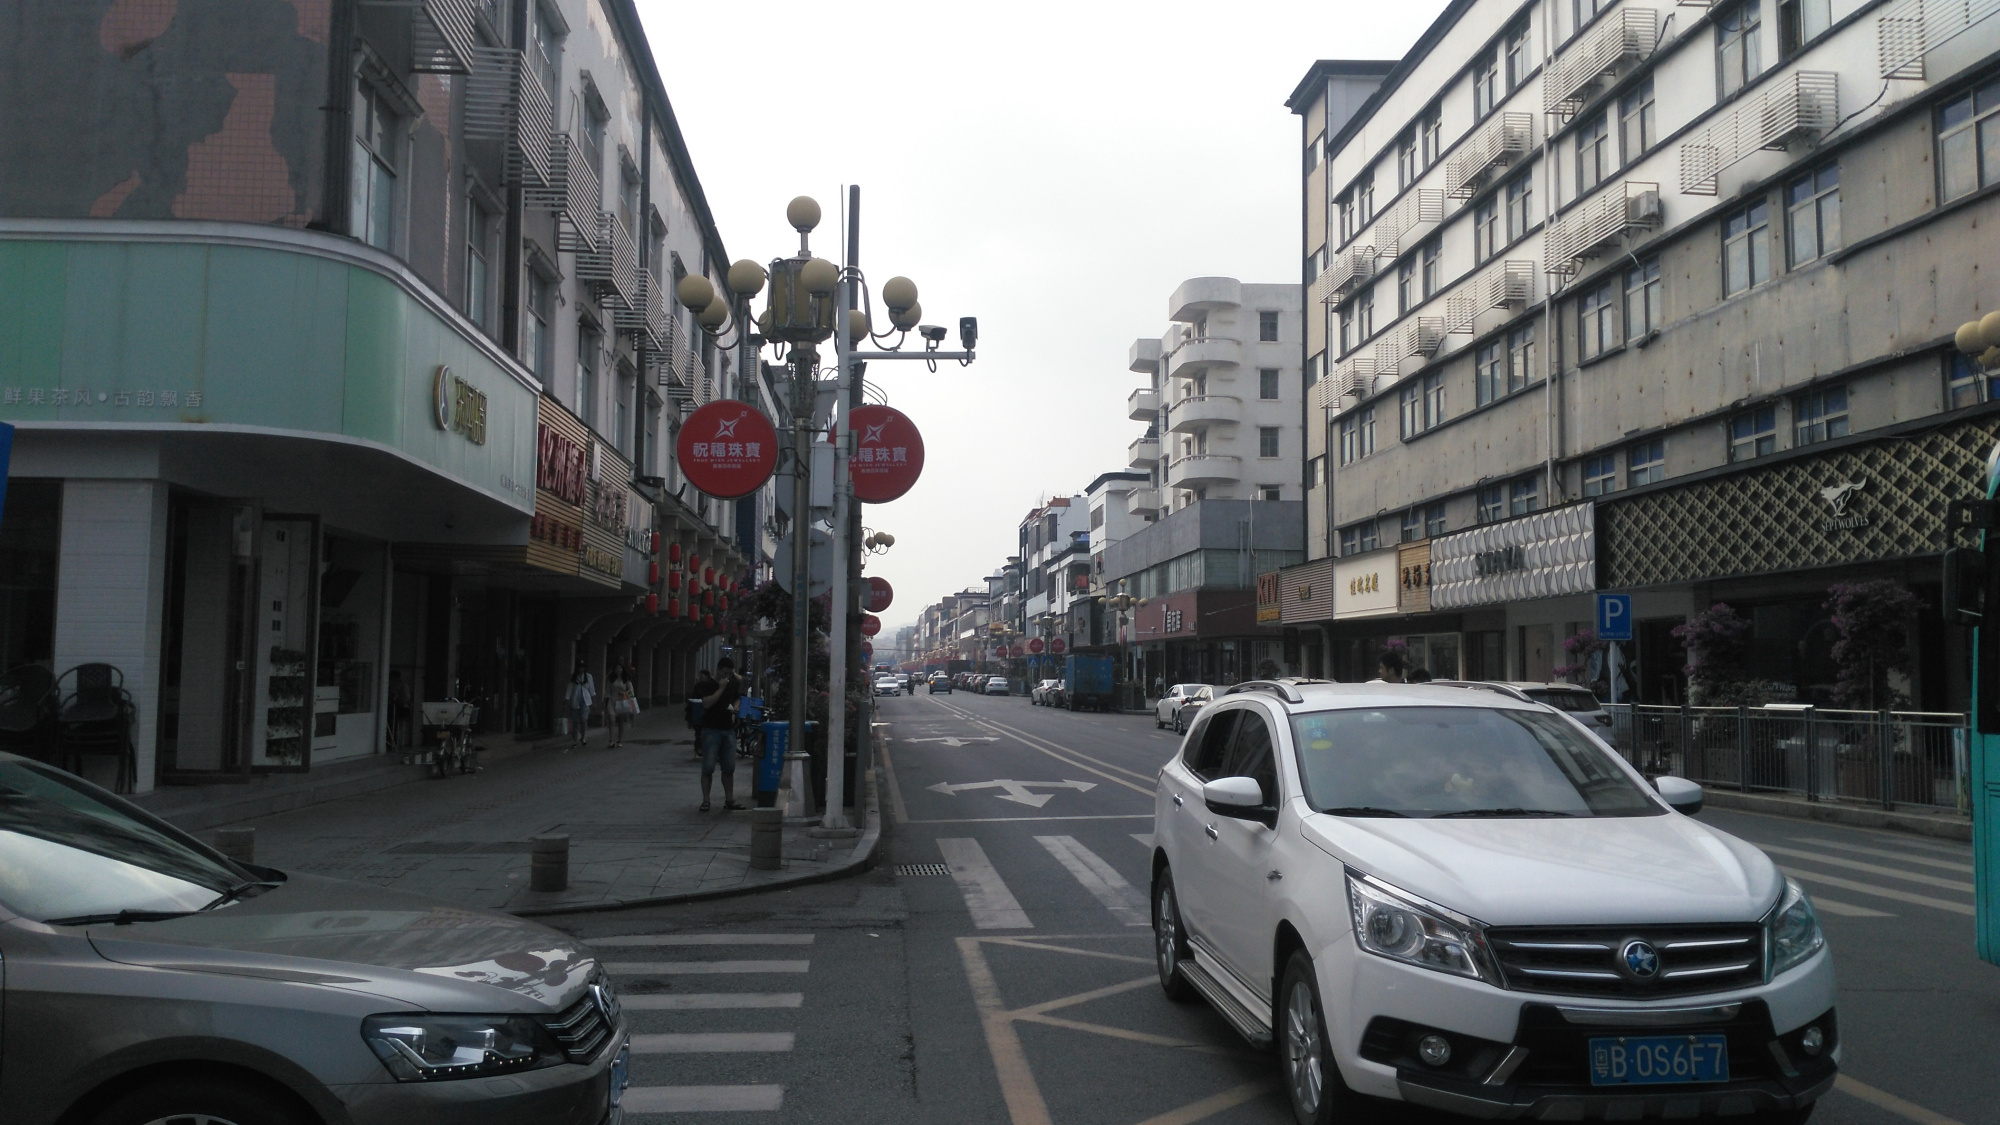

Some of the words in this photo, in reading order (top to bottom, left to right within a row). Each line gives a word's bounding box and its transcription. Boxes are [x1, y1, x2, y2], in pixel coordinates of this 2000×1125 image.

[693, 442, 761, 458] 祝福珠寶
[1821, 516, 1870, 532] SEPTWOLVES
[1257, 573, 1278, 605] KTV
[1605, 598, 1623, 628] P
